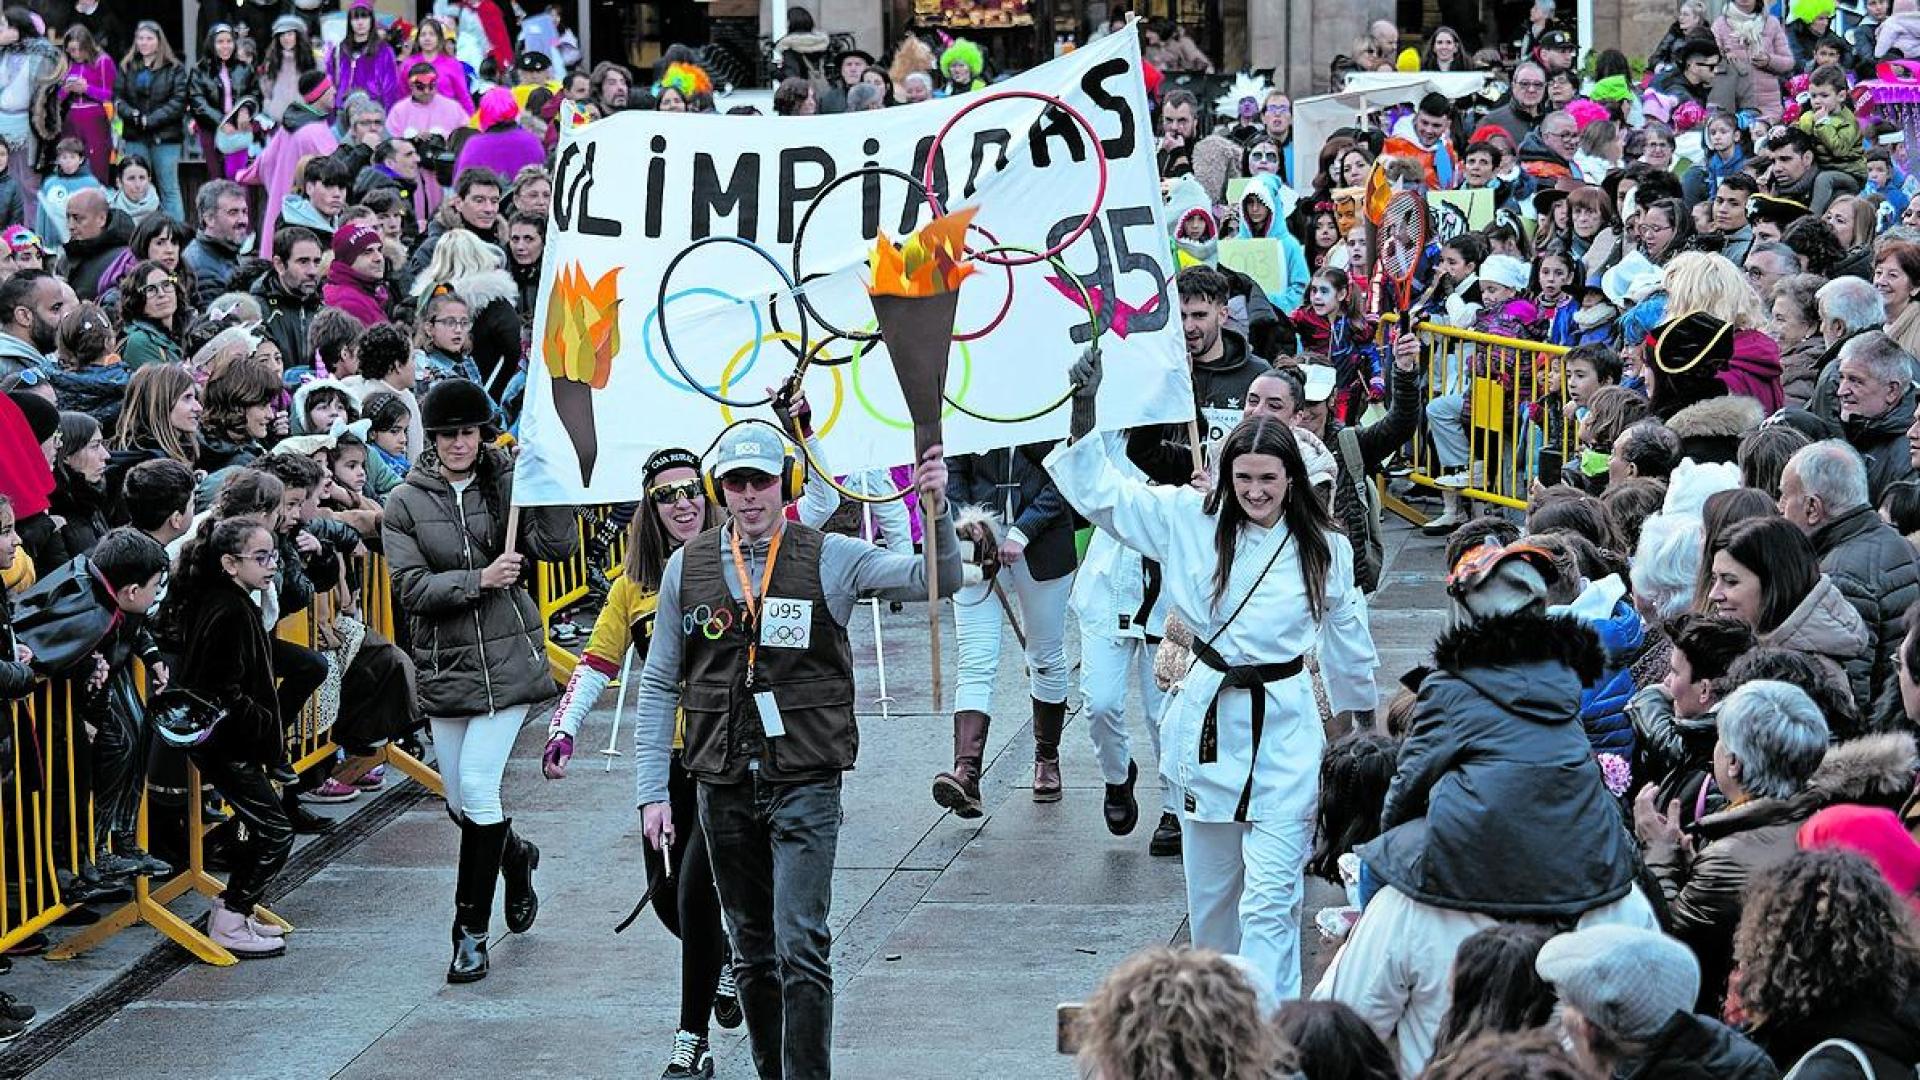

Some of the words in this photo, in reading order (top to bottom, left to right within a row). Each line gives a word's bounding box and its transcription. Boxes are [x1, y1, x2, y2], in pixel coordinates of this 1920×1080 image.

[1045, 205, 1171, 344] 95
[651, 456, 670, 469] CAJA
[770, 602, 802, 620] 095
